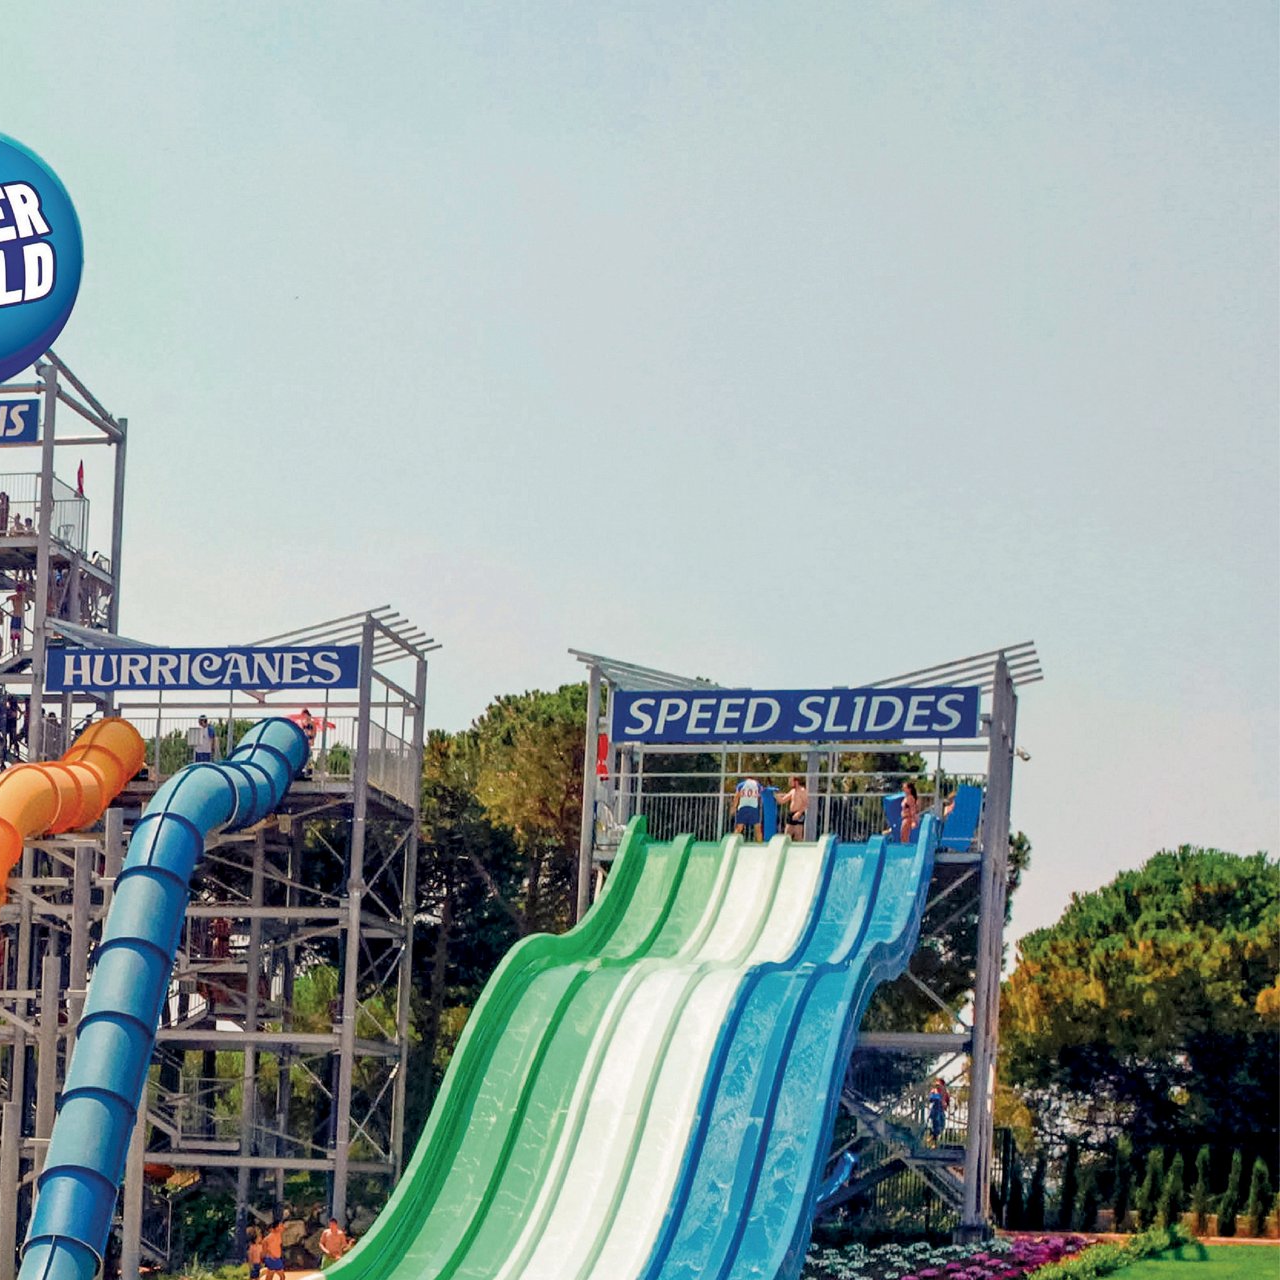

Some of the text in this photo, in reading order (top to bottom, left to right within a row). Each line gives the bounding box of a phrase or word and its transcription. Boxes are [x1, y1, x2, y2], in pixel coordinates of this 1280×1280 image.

[63, 652, 342, 686] HURRICANES
[624, 694, 965, 735] SPEED SLIDES
